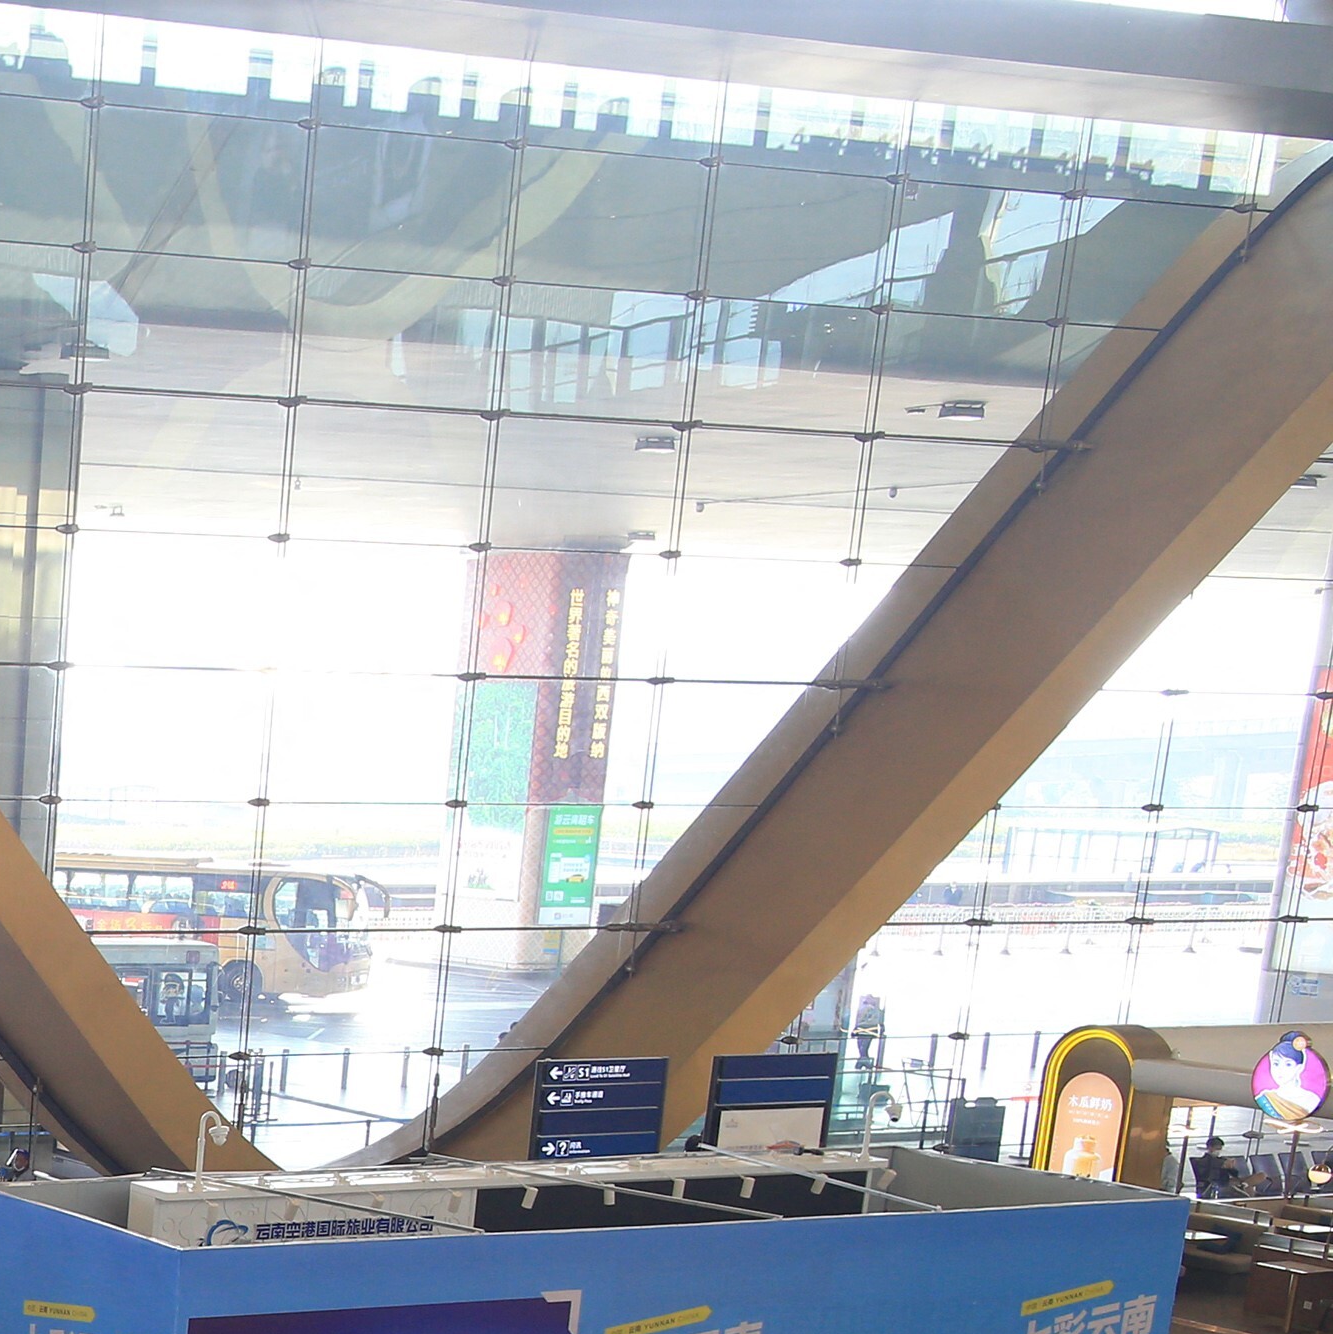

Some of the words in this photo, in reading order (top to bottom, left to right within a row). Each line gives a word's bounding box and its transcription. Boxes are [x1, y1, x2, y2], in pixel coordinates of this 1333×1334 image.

[553, 588, 585, 759] 世界著名的旅游目的地
[590, 589, 620, 759] 神奇美丽的西双版纳
[578, 1067, 590, 1078] S1
[1068, 1095, 1112, 1111] 木瓜鲜奶
[255, 1216, 434, 1241] 云南空港国际旅业有限公司
[643, 1318, 675, 1331] YUNNAN
